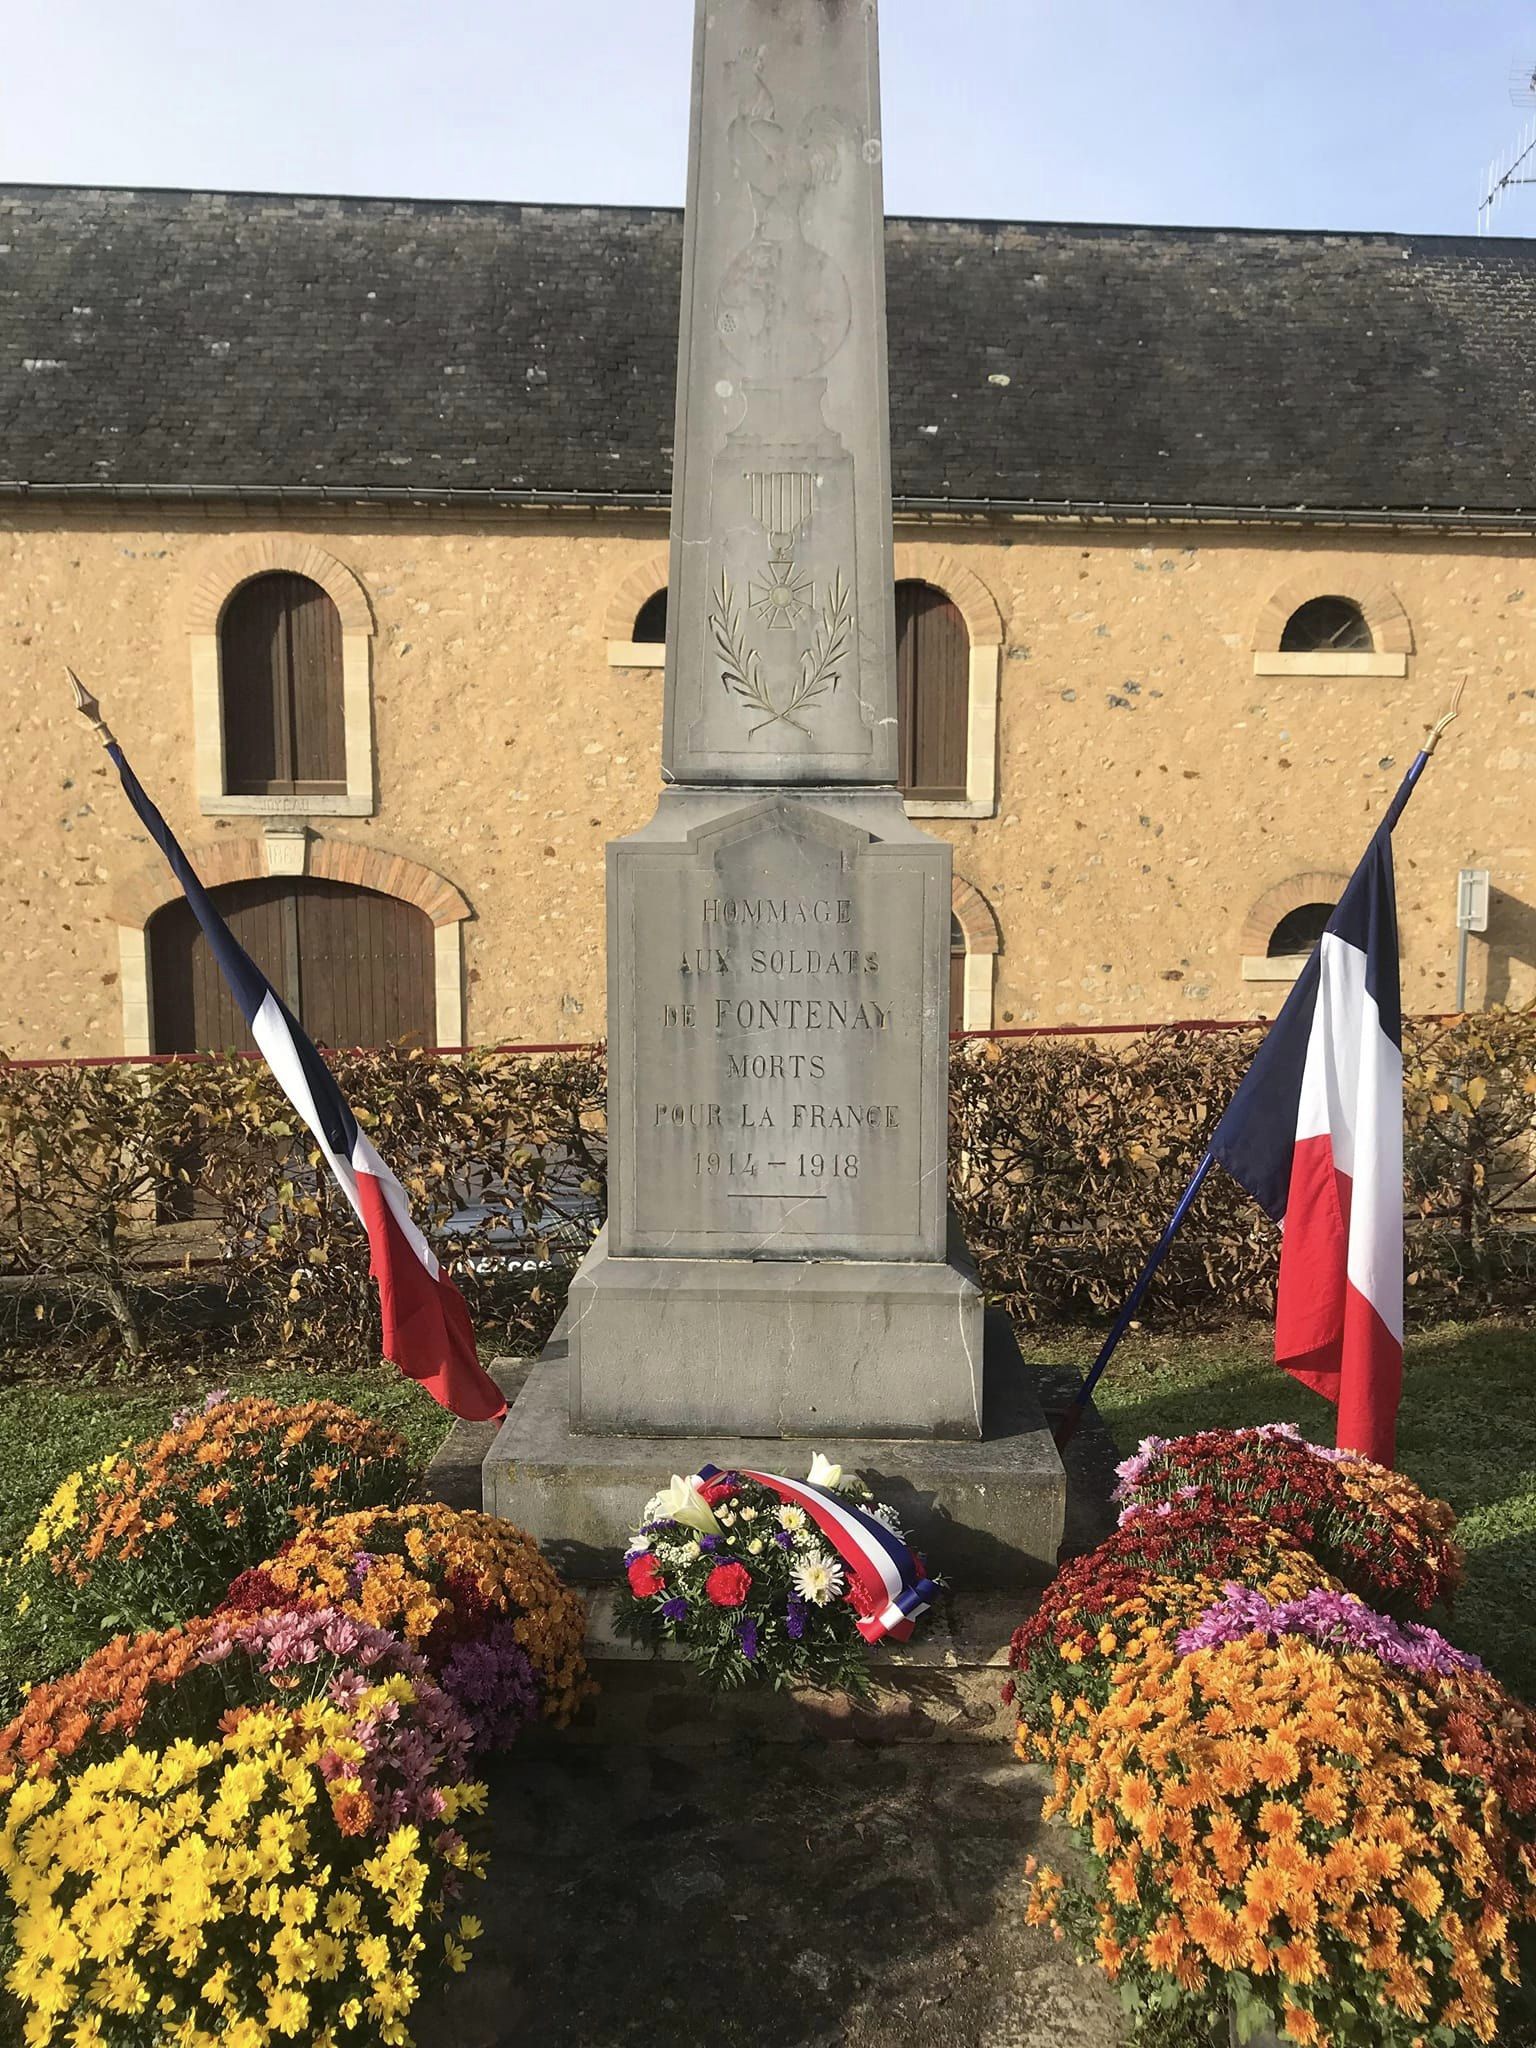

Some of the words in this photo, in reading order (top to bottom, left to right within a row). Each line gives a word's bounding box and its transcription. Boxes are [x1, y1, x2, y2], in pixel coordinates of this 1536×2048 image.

[702, 899, 852, 923] HOMMAGE
[680, 949, 731, 975] AUX
[751, 950, 880, 975] SOLDATS
[663, 1004, 696, 1029] DE
[715, 999, 895, 1031] FONTENAY
[727, 1054, 826, 1079] MORTS
[654, 1103, 722, 1128] POUR
[741, 1104, 775, 1127] LA
[792, 1104, 899, 1128] FRANCE
